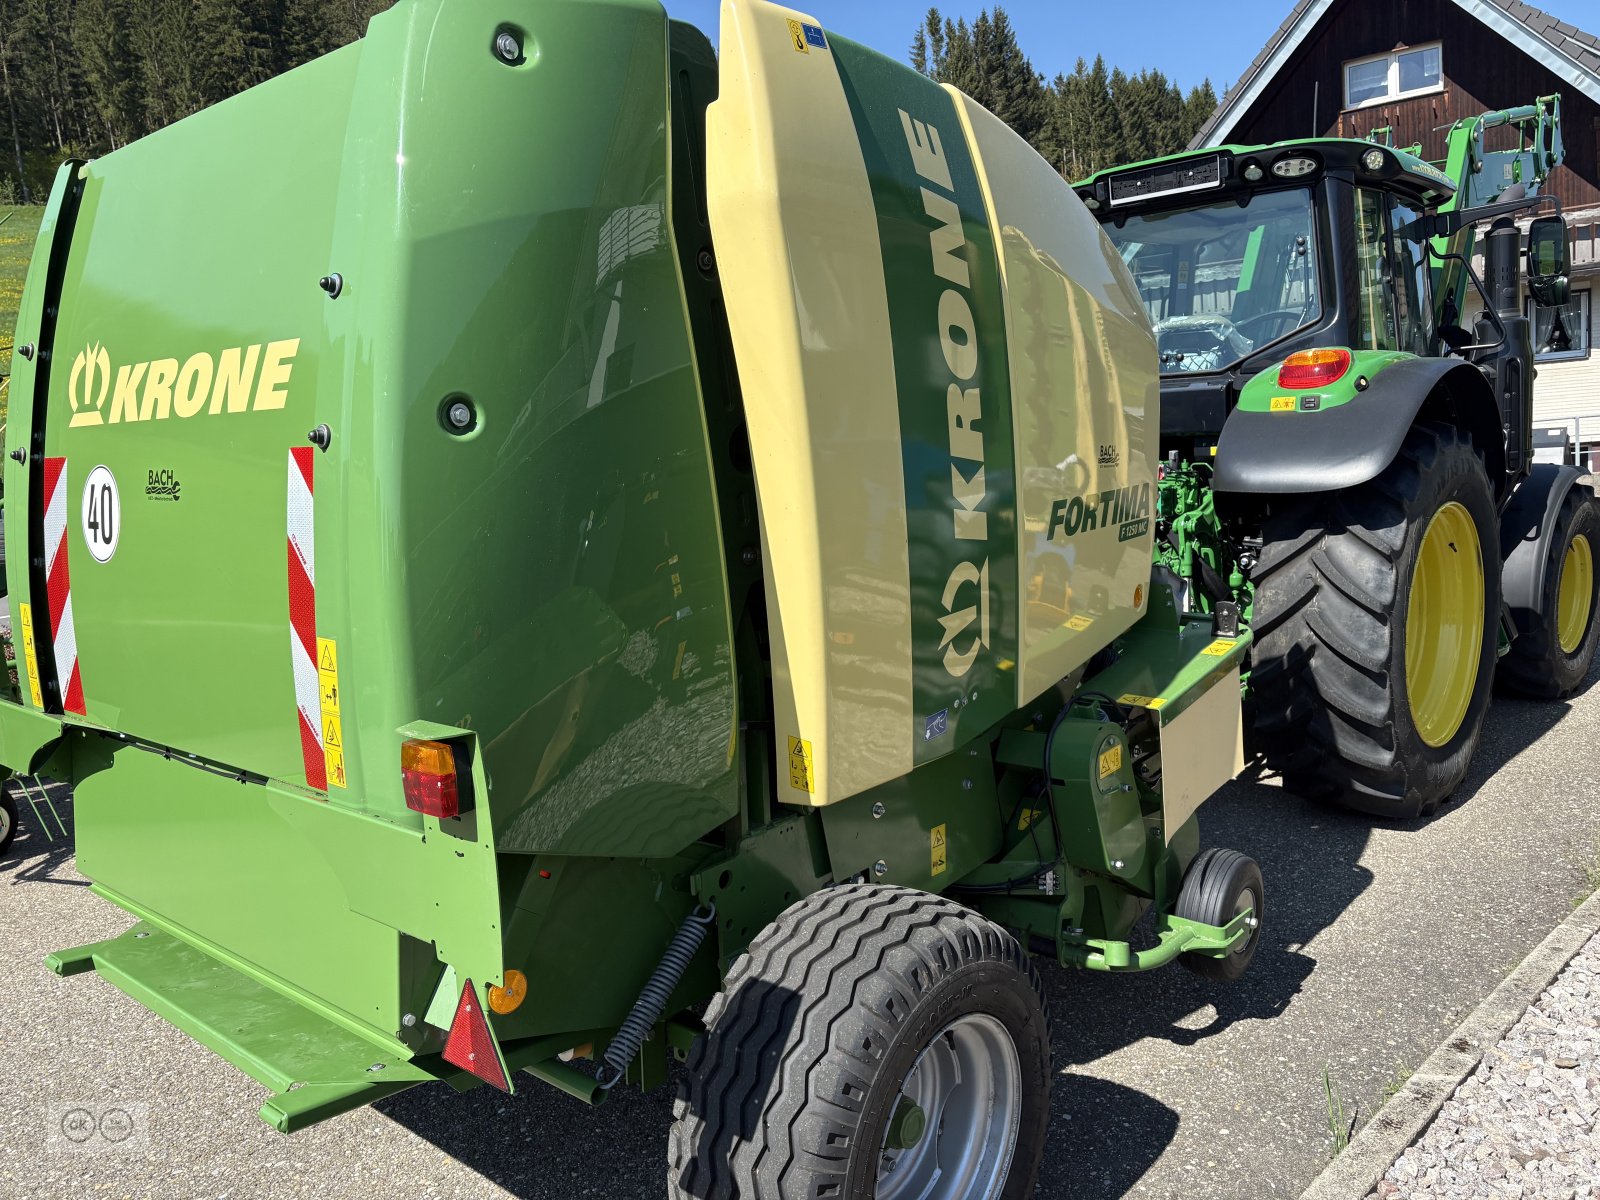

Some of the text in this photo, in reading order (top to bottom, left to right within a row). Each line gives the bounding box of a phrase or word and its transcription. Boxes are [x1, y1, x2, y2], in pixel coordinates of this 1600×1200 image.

[897, 107, 988, 541] KRONE
[108, 337, 301, 424] KRONE
[148, 469, 174, 486] BACH
[1100, 445, 1116, 458] BACH
[88, 484, 113, 545] 40
[1047, 482, 1150, 541] FORTIMA
